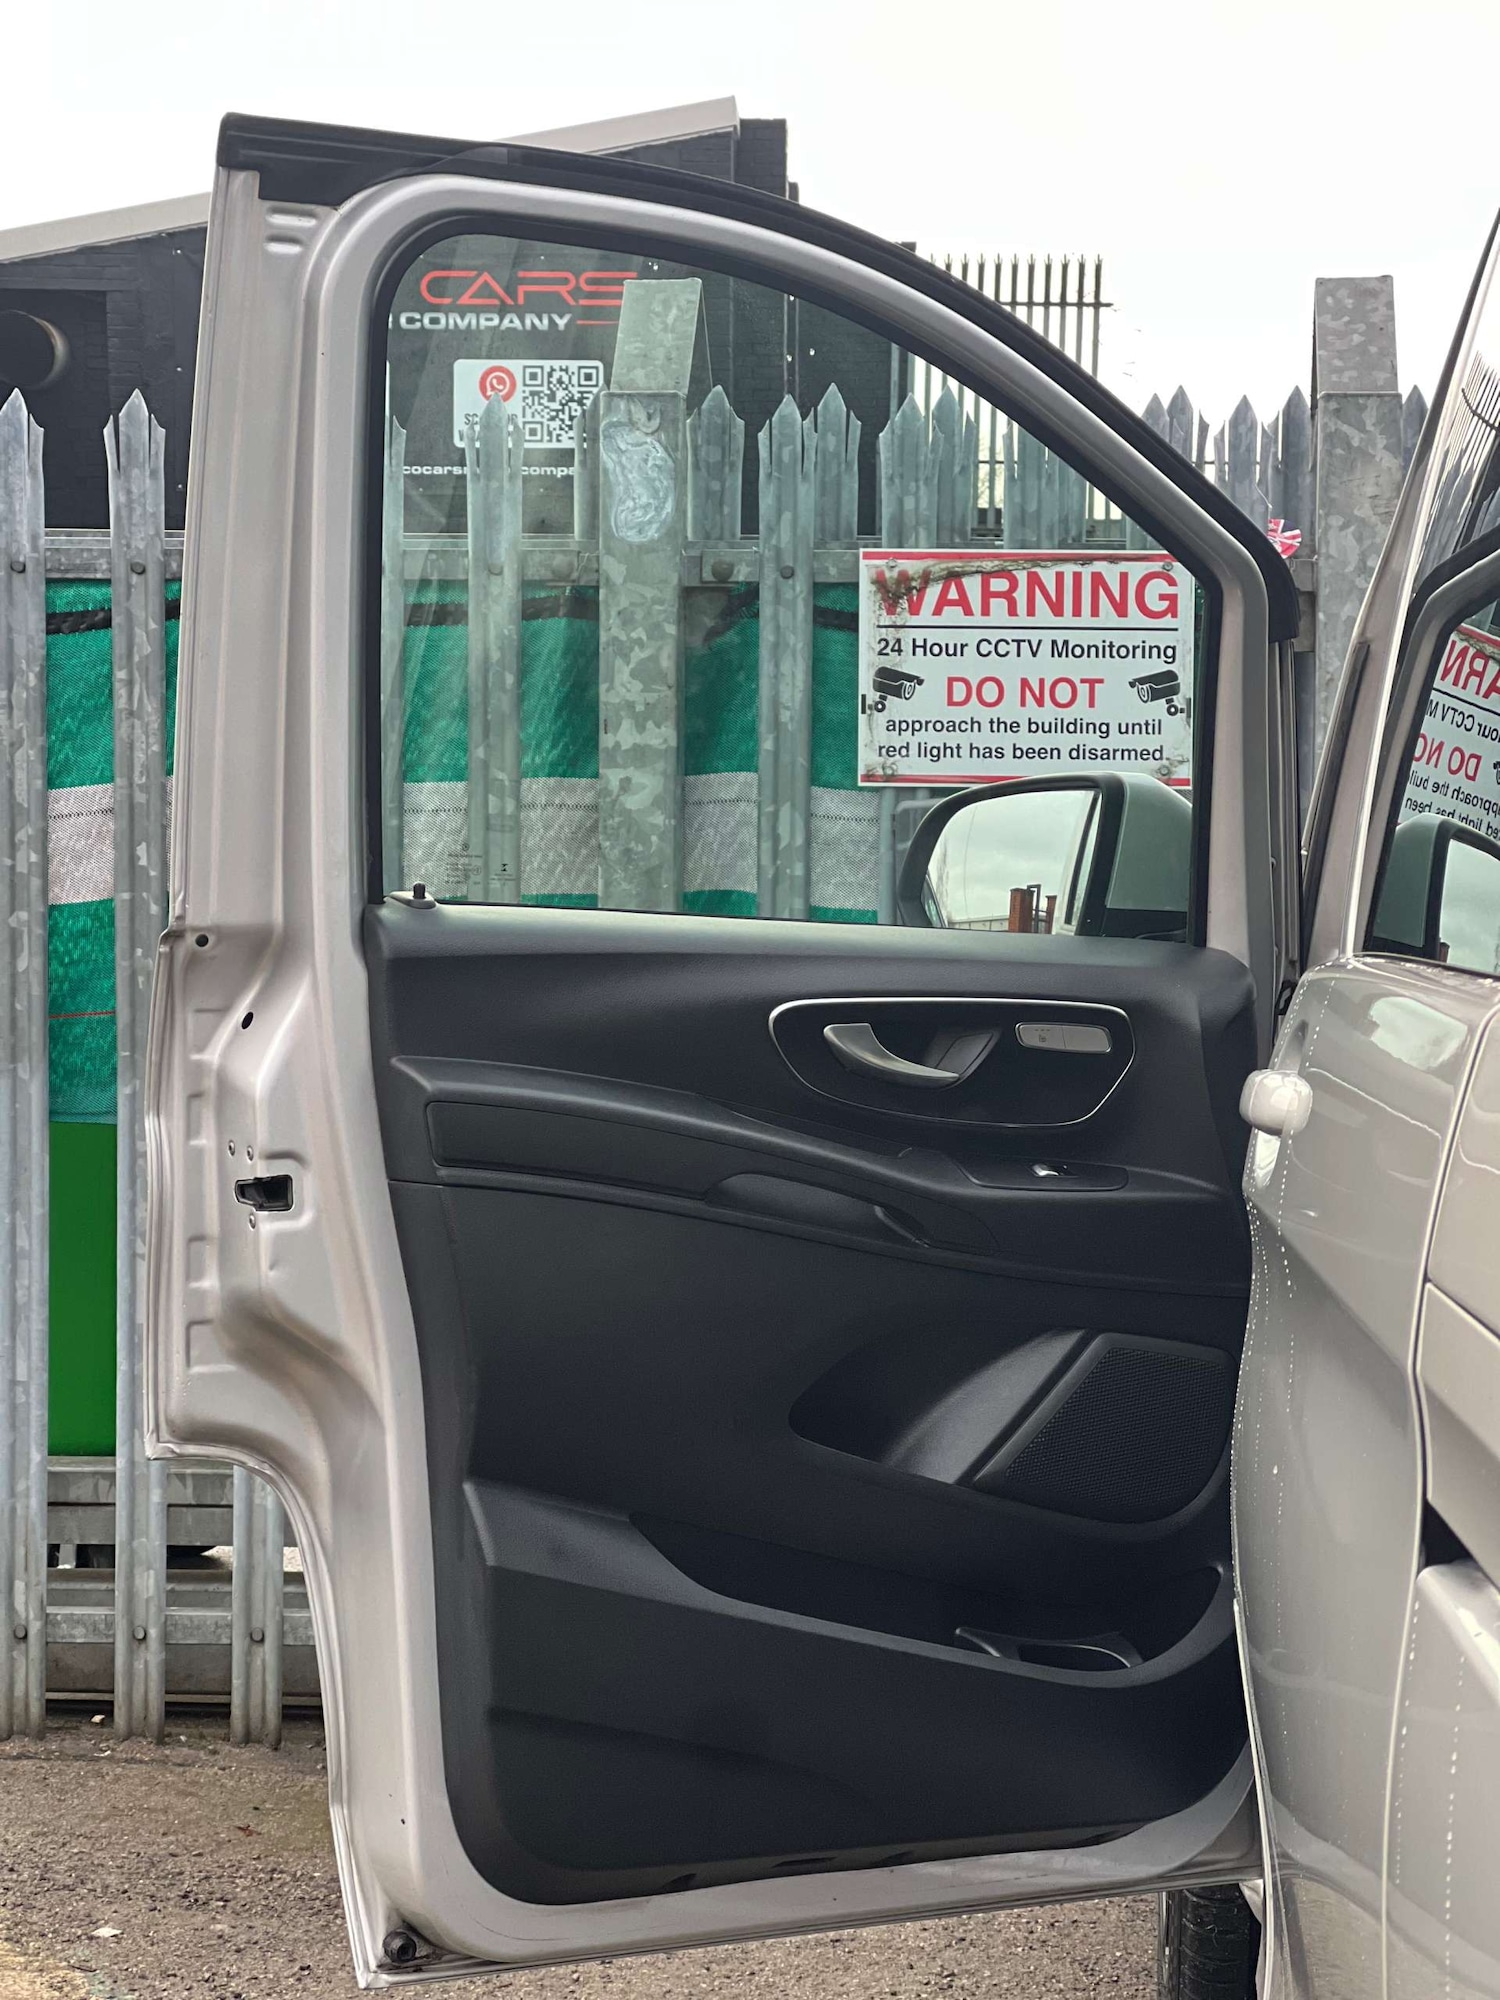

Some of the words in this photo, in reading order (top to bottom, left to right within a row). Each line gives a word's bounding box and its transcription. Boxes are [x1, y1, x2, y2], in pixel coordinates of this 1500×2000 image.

[420, 270, 638, 306] CARS
[400, 312, 572, 331] COMPANY
[875, 569, 1179, 619] WARNING
[877, 638, 903, 656] 24
[912, 638, 968, 657] Hour
[976, 638, 1043, 658] CCTV
[1051, 639, 1177, 664] Monitoring
[946, 676, 1005, 708] DO
[1020, 677, 1104, 709] NOT
[886, 716, 981, 736] approach
[989, 717, 1020, 733] the
[1028, 717, 1110, 739] building
[1118, 719, 1162, 735] until
[878, 742, 910, 758] red
[918, 742, 962, 763] light
[969, 743, 1005, 759] has
[1012, 743, 1061, 760] been
[1068, 744, 1163, 761] disarmed
